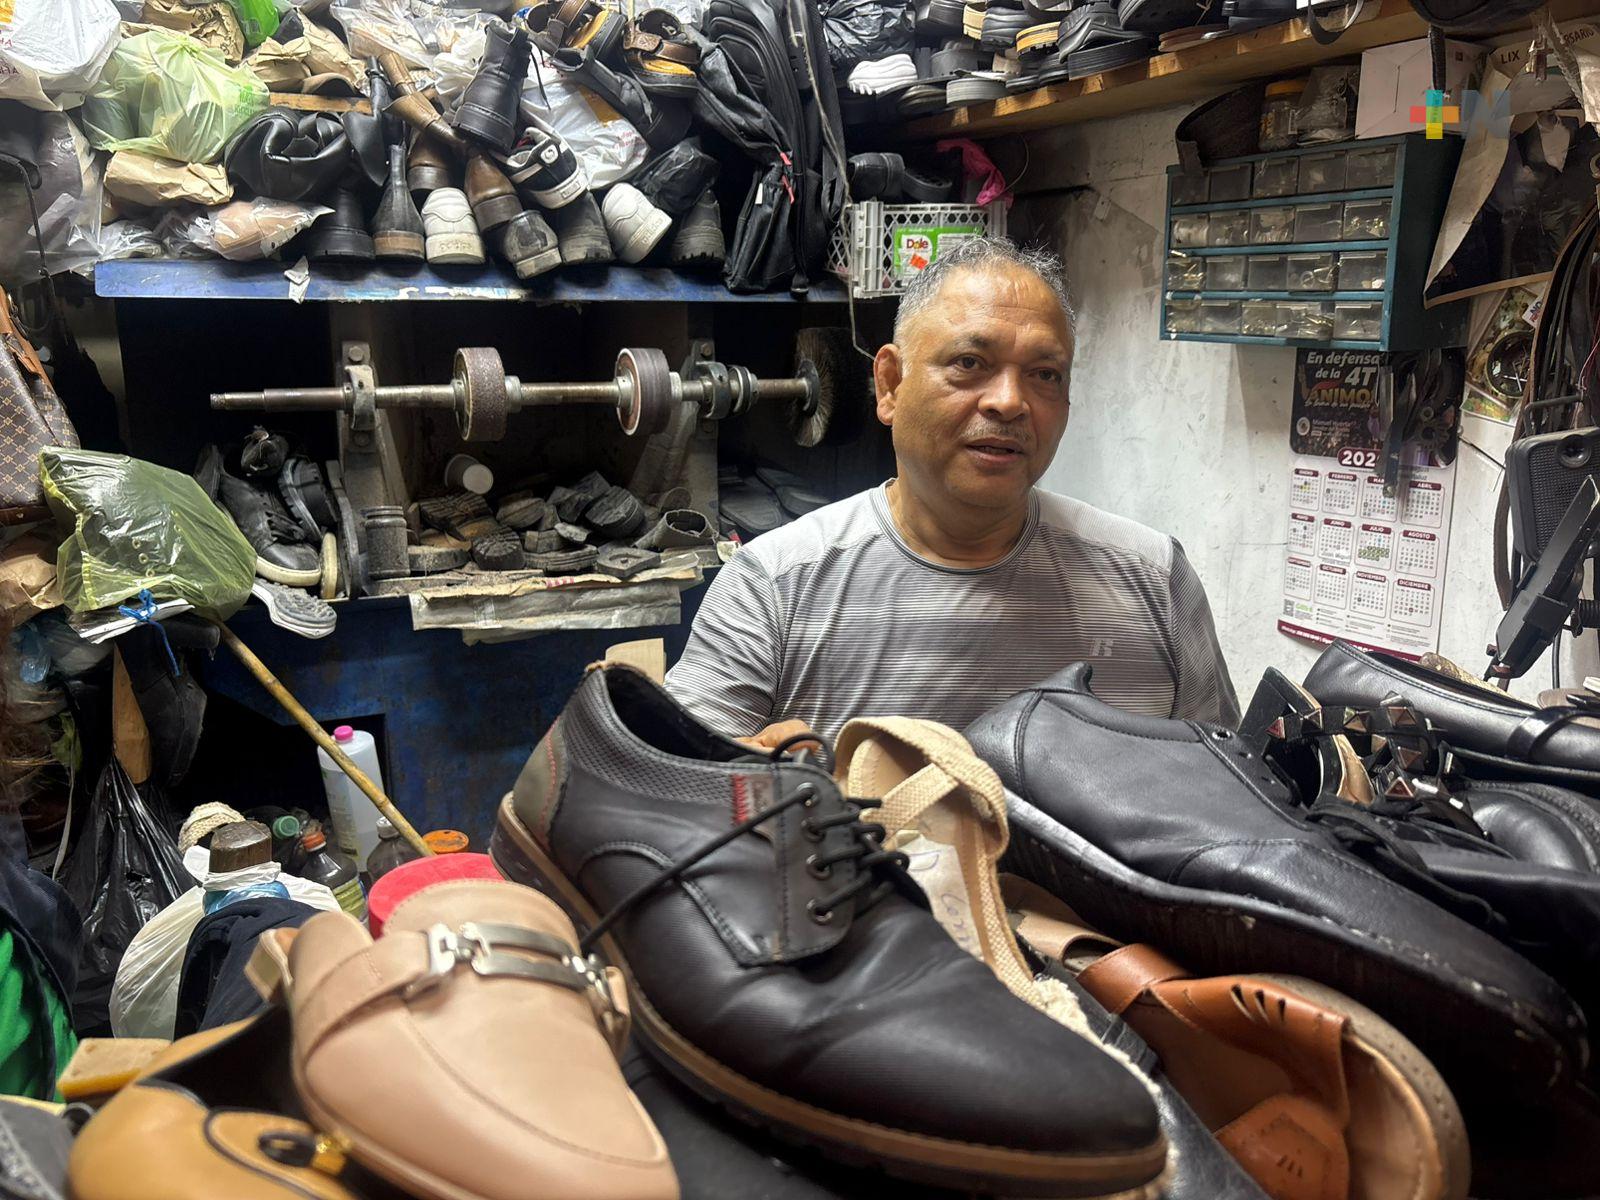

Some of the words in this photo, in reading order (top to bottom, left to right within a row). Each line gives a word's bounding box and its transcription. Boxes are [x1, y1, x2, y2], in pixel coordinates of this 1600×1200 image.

[1501, 50, 1520, 64] LIX
[906, 237, 929, 249] Dole
[1306, 351, 1322, 364] En
[1326, 351, 1379, 367] defensa
[1316, 368, 1329, 378] de
[1330, 368, 1340, 379] la
[1345, 367, 1376, 386] 4T
[1341, 450, 1379, 467] 202
[1331, 473, 1354, 481] FEBRERO
[1408, 531, 1431, 540] AGOSTO
[1356, 571, 1386, 582] NOVIEMBRE
[1399, 579, 1429, 590] DICIEMBRE
